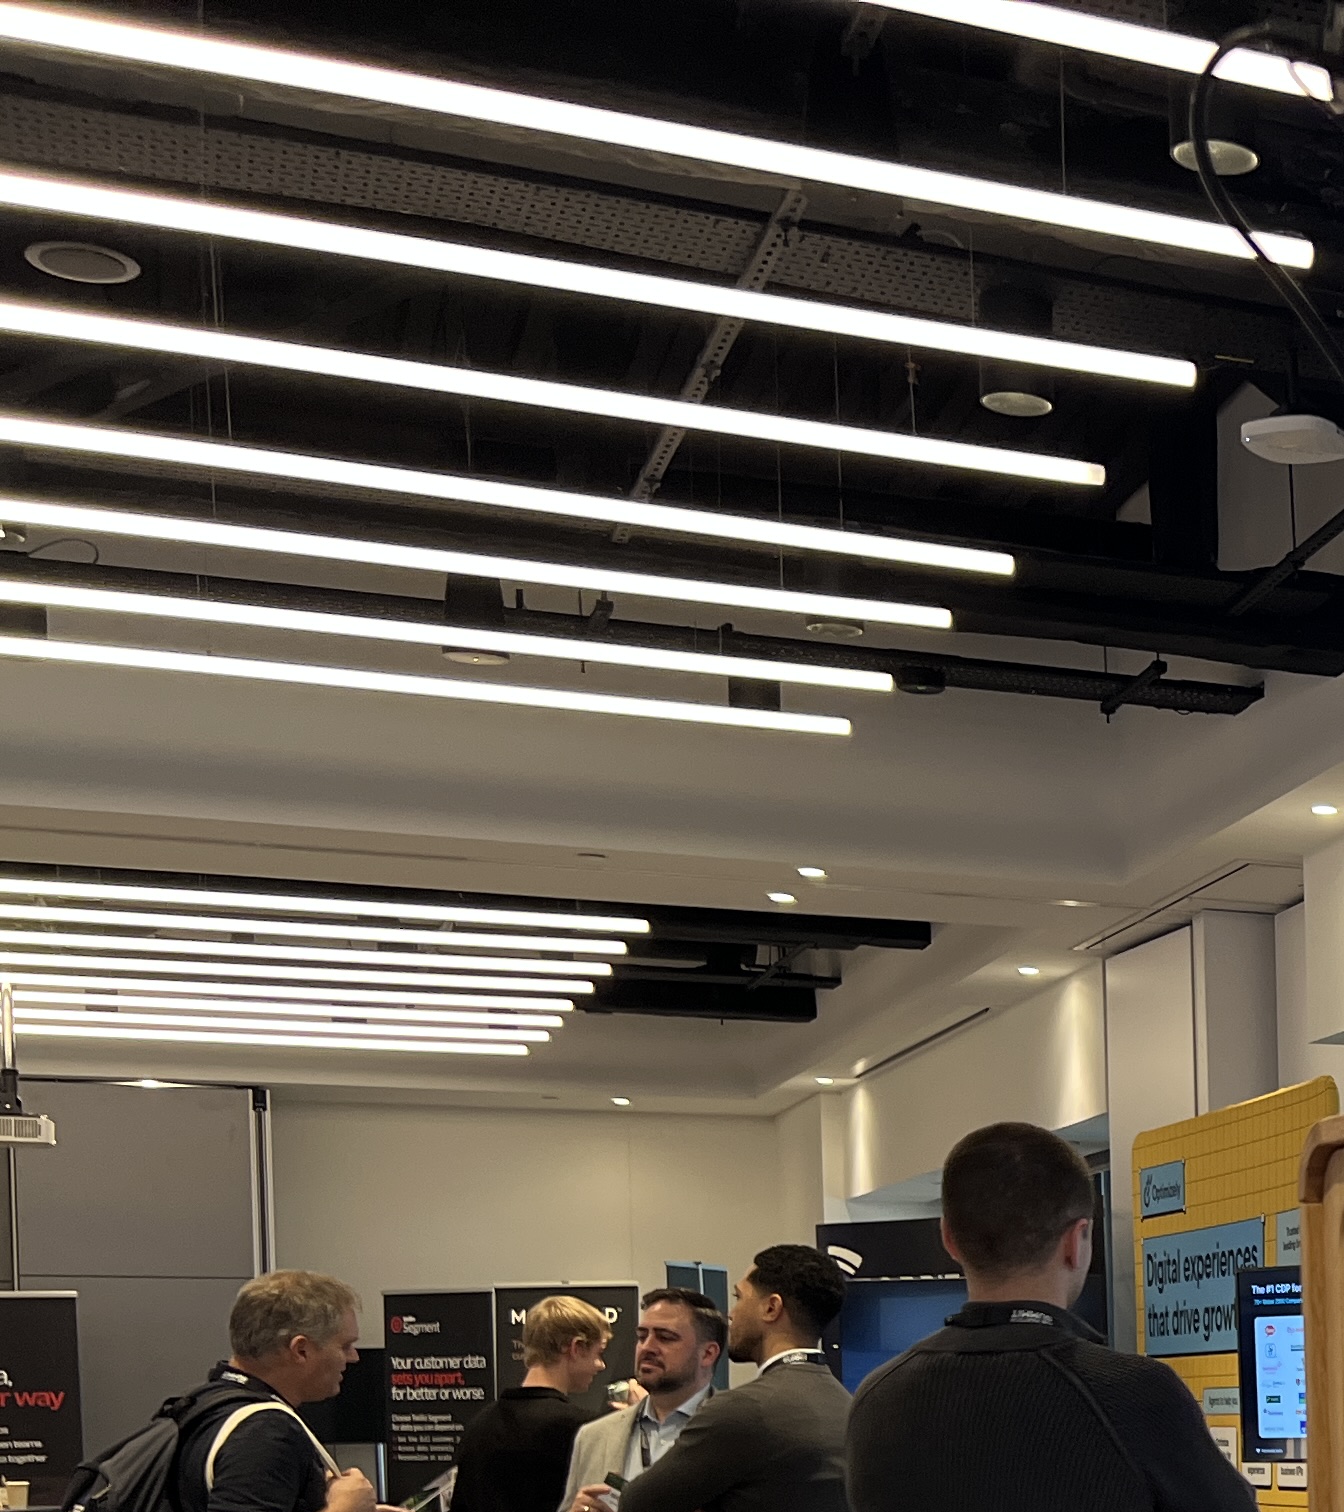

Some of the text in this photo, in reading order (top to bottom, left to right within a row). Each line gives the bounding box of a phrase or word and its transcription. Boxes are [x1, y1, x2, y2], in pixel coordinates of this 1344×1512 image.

[1146, 1242, 1258, 1294] Digital experiences
[1251, 1284, 1266, 1295] The
[1275, 1283, 1291, 1294] CDP
[1148, 1304, 1170, 1337] that
[1172, 1300, 1200, 1337] drive
[403, 1321, 441, 1336] Segment
[391, 1354, 486, 1370] Your customer data
[0, 1369, 13, 1387] a,
[391, 1372, 413, 1385] sets
[414, 1373, 433, 1388] you
[391, 1386, 485, 1400] for better or worse
[14, 1391, 65, 1412] way
